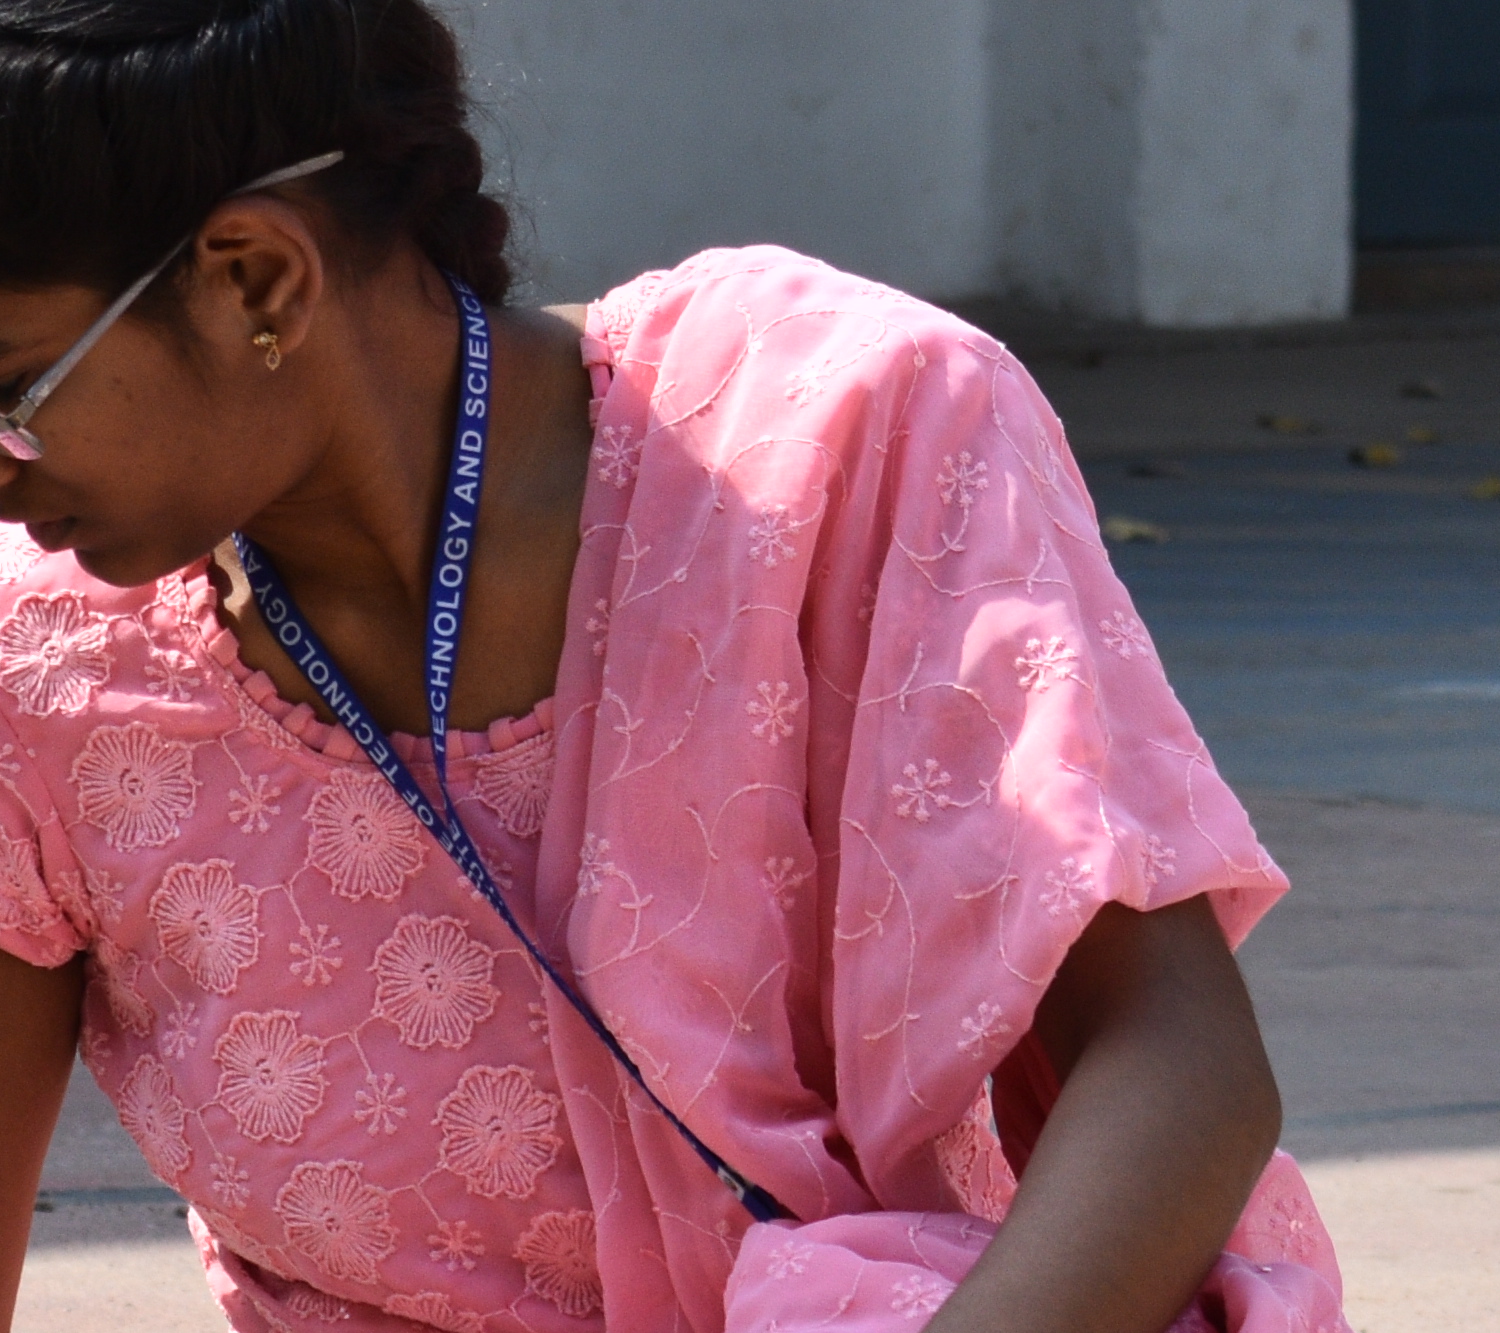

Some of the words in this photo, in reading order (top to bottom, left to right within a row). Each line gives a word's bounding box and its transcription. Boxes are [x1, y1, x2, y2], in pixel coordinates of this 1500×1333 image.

[450, 274, 488, 419] SCIENCE
[453, 430, 482, 505] AND
[254, 582, 399, 785] TECHNOLOGY
[430, 511, 472, 753] TECHNOLOGY
[401, 789, 434, 827] OF
